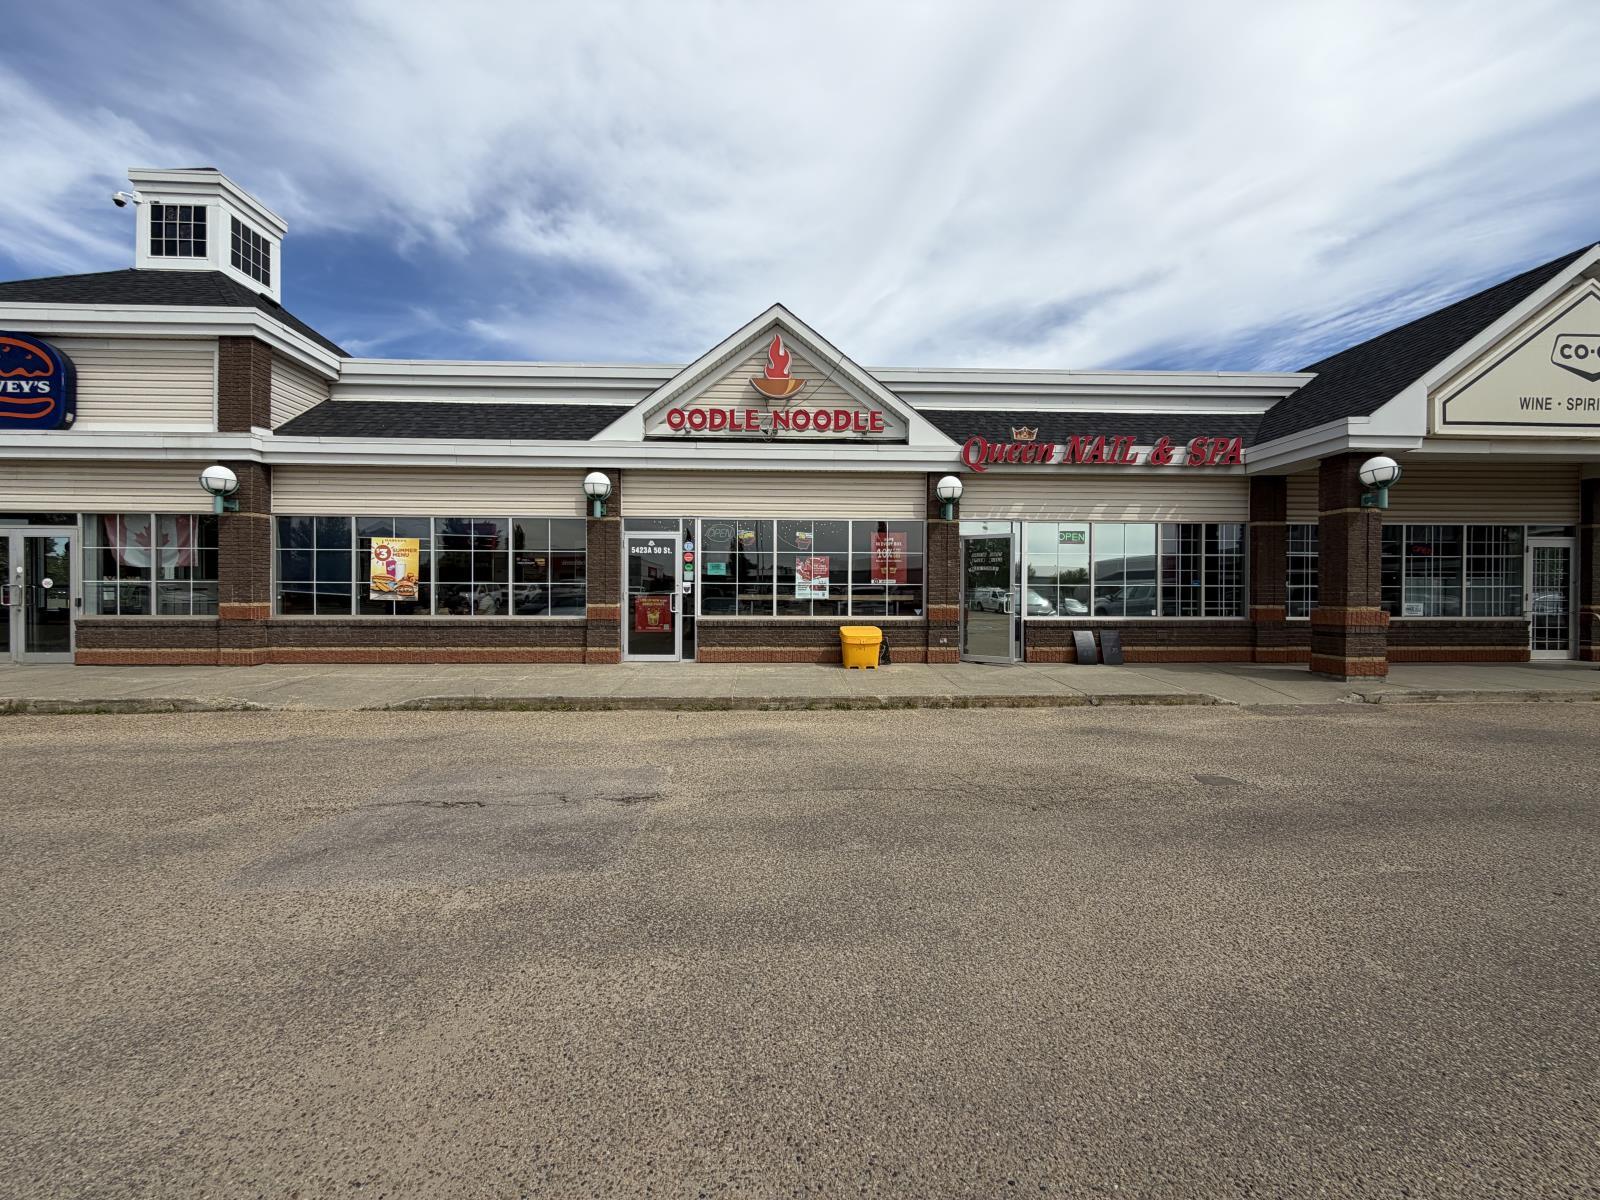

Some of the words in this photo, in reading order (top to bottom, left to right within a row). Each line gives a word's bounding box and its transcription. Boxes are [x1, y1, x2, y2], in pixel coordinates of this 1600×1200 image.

[1520, 397, 1552, 411] WINE
[666, 408, 760, 432] OODLE
[772, 409, 885, 433] NOODLE
[962, 436, 1056, 472] Queen
[1063, 435, 1139, 465] NAIL
[1150, 436, 1175, 466] &
[1187, 436, 1243, 466] SPA
[708, 528, 732, 538] OPEN
[1059, 532, 1085, 541] OPEN
[631, 546, 652, 554] 5423A
[654, 546, 662, 554] 50
[663, 546, 673, 554] St.
